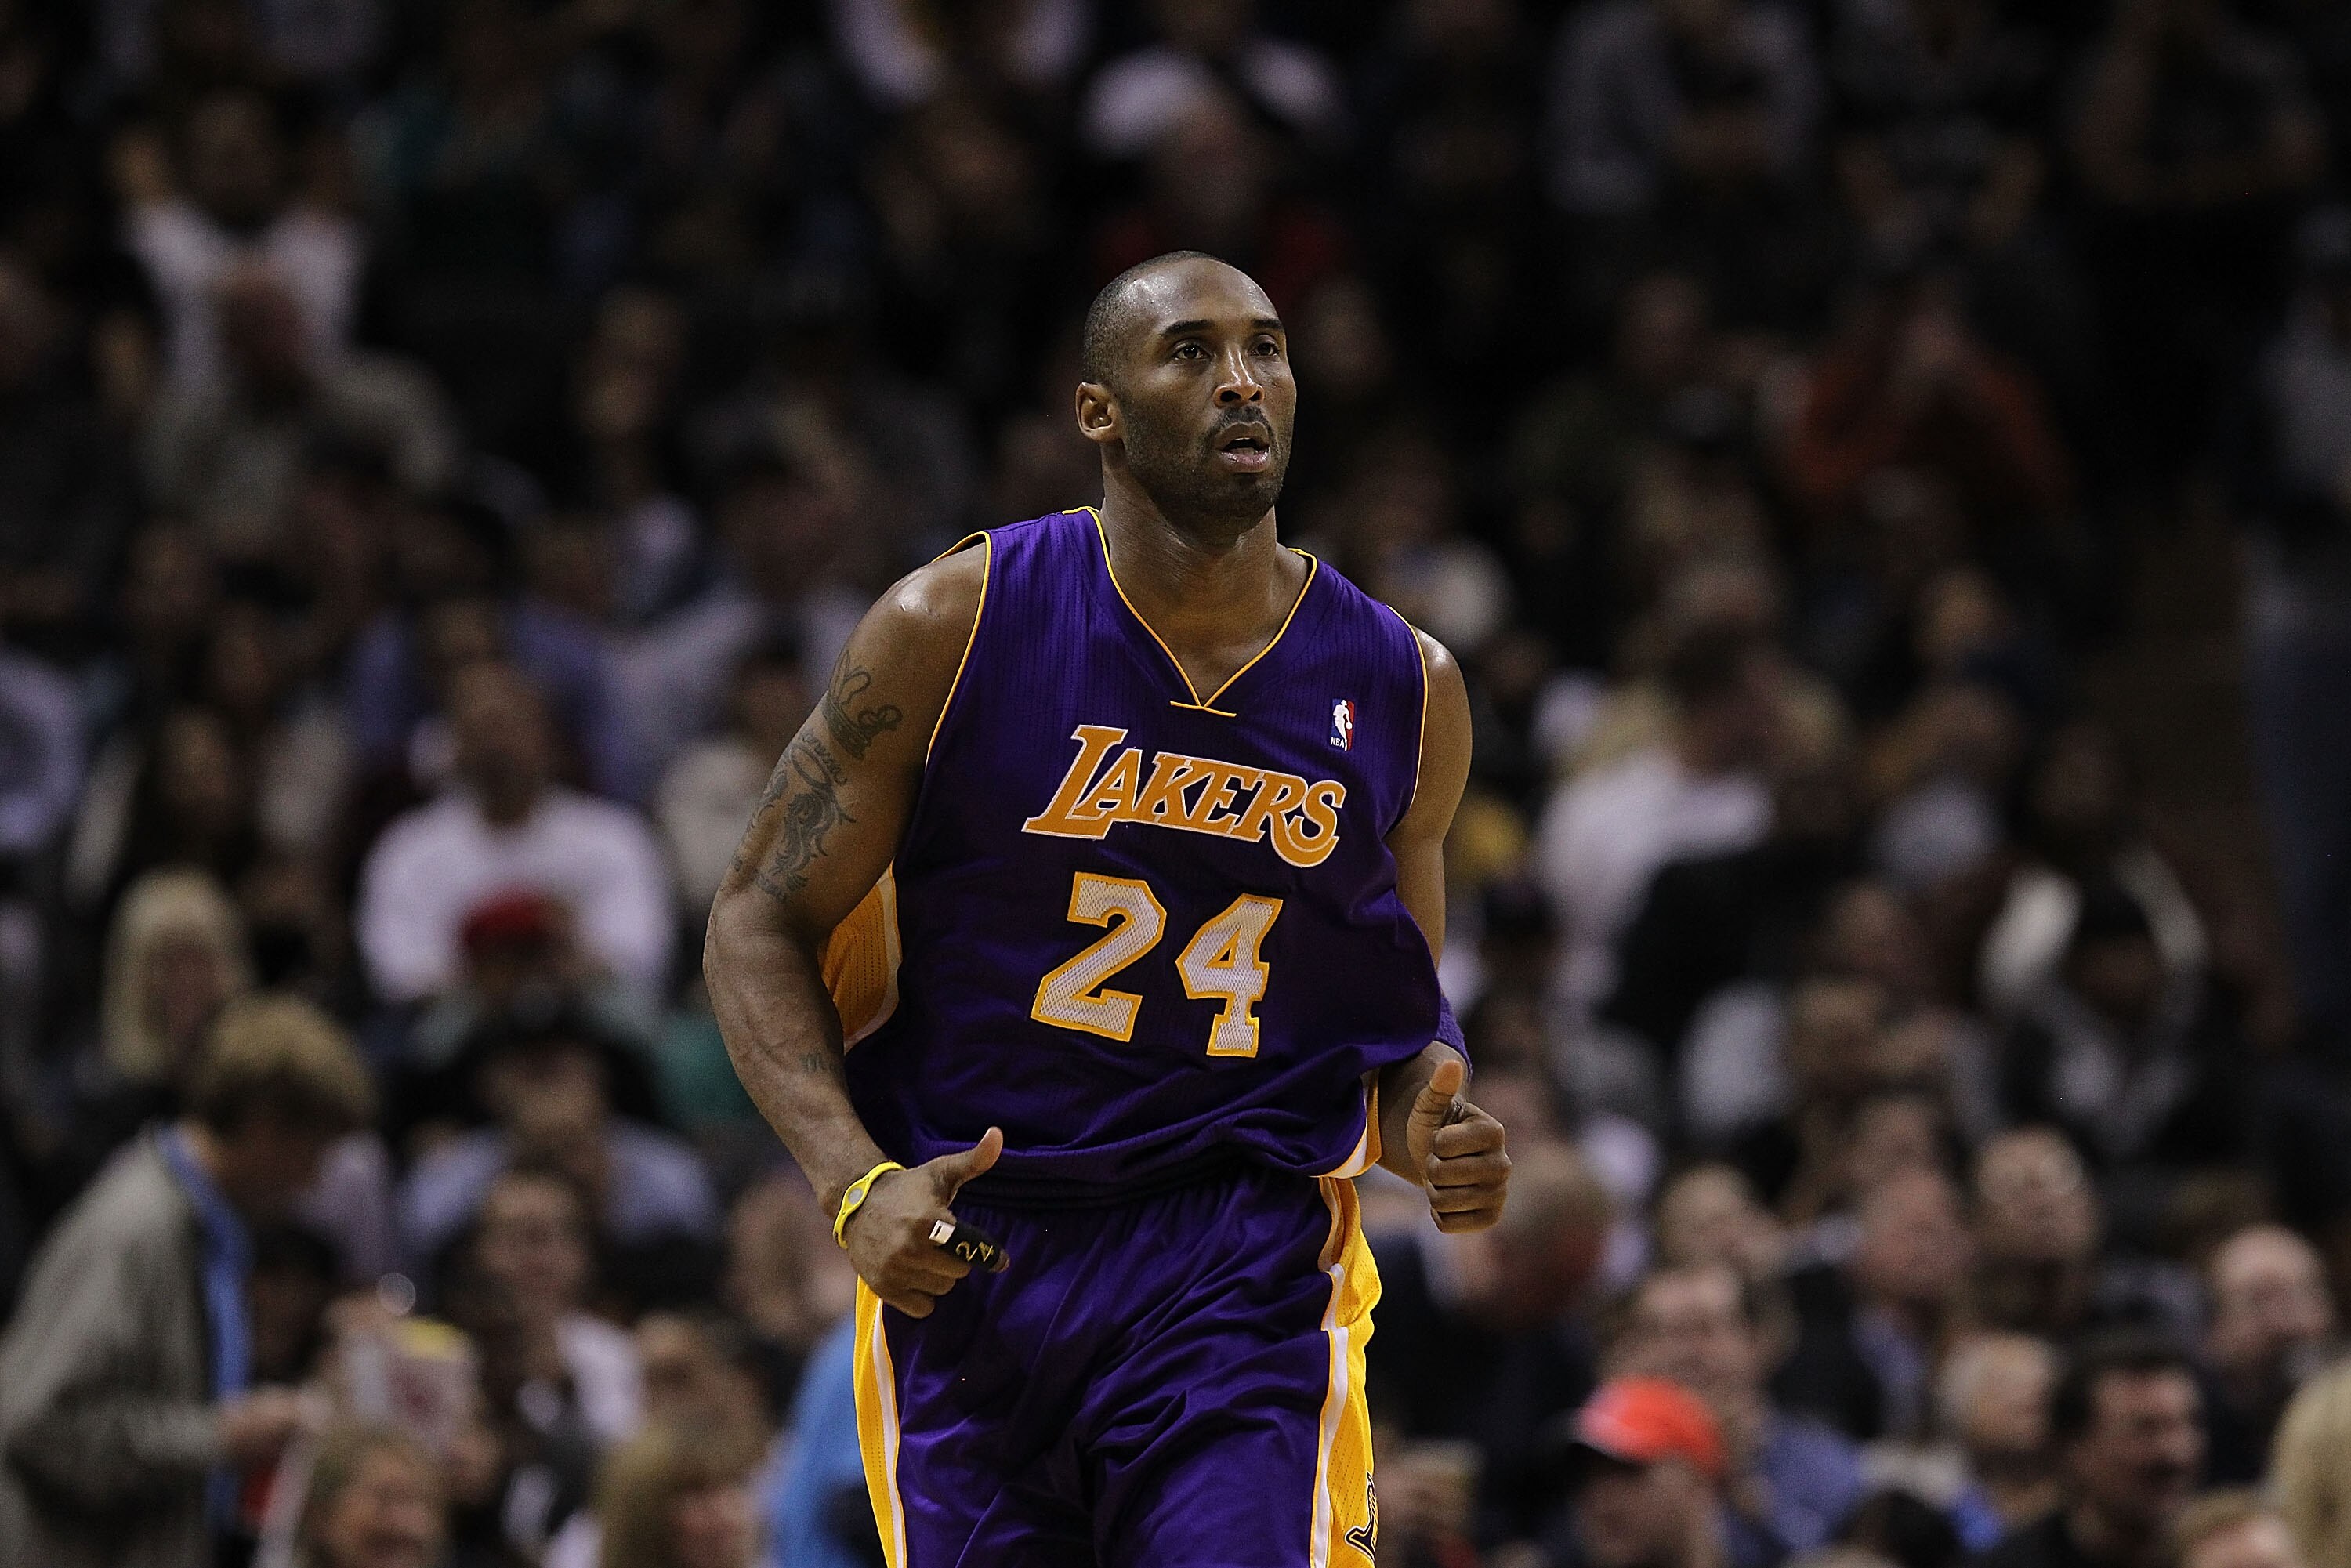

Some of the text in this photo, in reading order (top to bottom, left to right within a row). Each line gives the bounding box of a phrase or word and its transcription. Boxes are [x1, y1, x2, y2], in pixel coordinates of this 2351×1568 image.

[1330, 737, 1345, 748] NBA
[1020, 723, 1347, 868] LAKERS
[1030, 871, 1284, 1058] 24
[955, 1240, 994, 1262] 24
